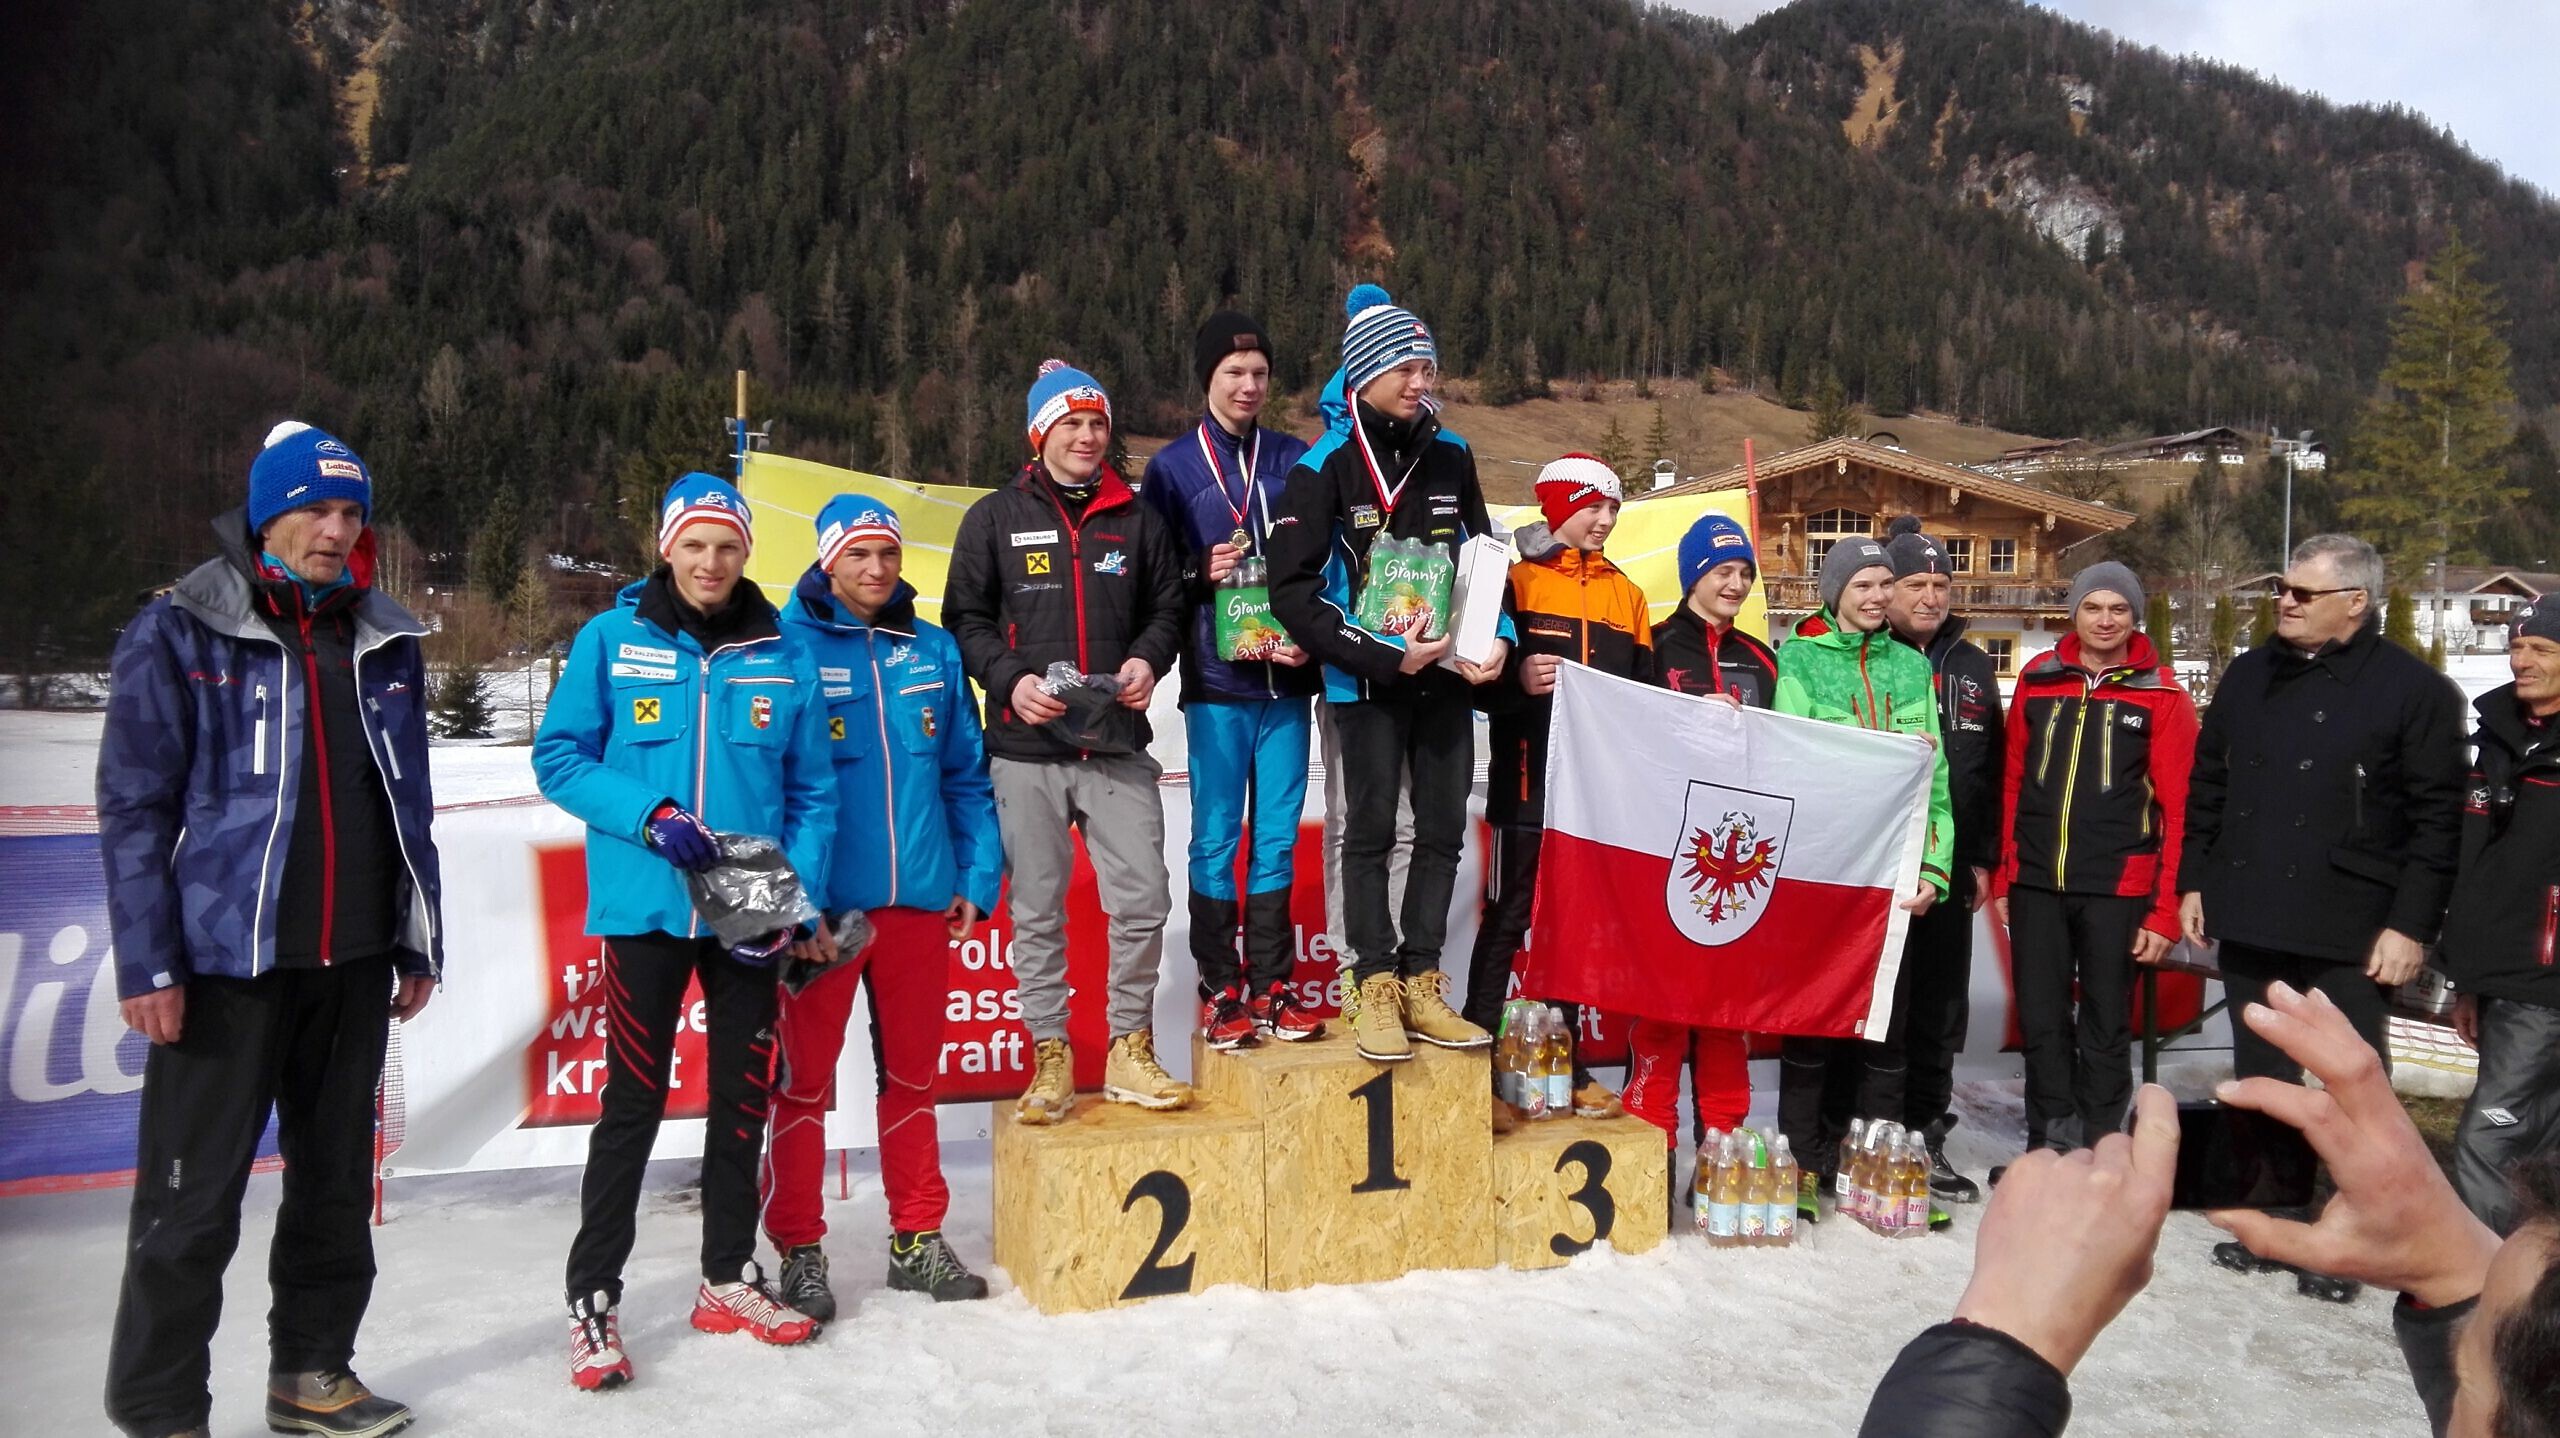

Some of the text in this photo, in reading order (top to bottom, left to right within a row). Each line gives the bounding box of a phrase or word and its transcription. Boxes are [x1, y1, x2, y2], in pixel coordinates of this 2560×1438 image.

[1569, 485, 1594, 502] Eisbär
[1227, 595, 1271, 623] Grann
[1339, 629, 1361, 644] VIST
[938, 1029, 1025, 1075] raft
[1348, 1068, 1412, 1194] 1
[1549, 1139, 1617, 1257] 3
[1119, 1170, 1197, 1301] 2
